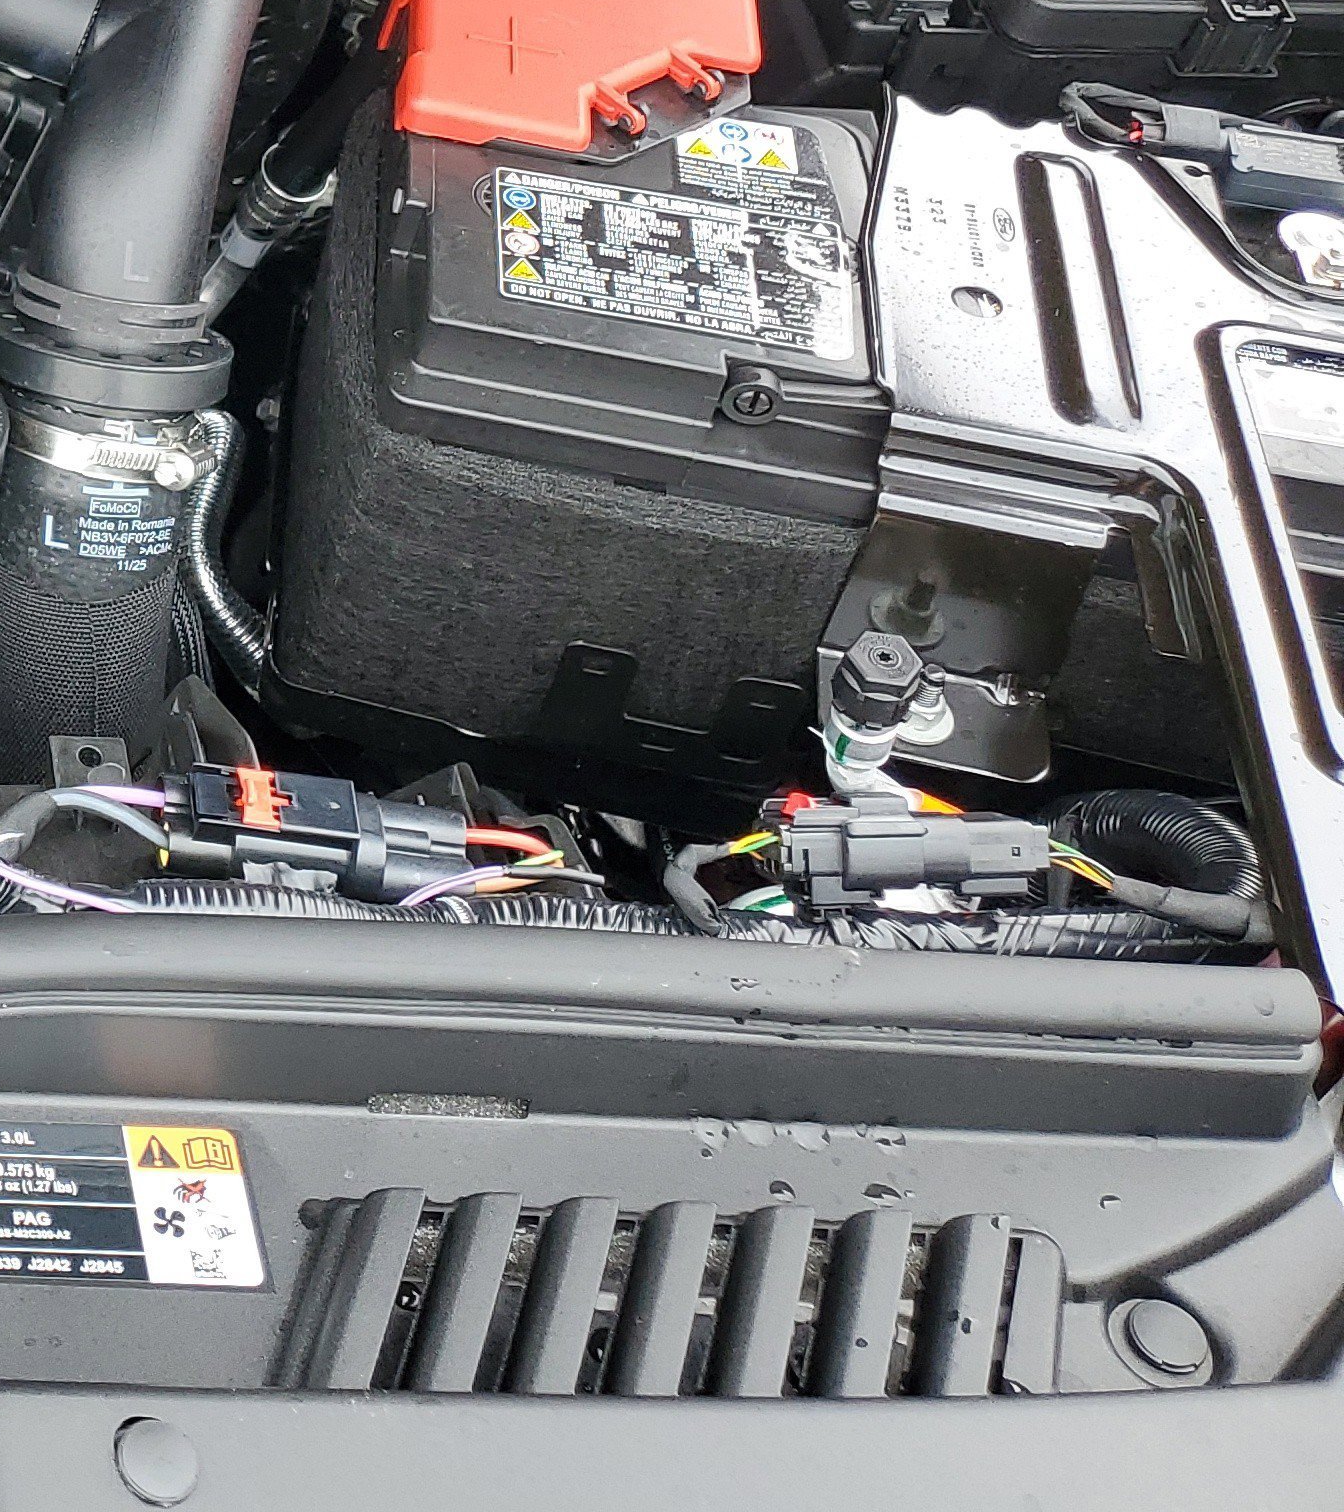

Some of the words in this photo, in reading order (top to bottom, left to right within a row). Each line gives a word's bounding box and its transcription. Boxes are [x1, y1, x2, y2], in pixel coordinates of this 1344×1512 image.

[510, 283, 527, 294] DO
[529, 286, 552, 299] NOT
[553, 290, 587, 306] OPEN.
[609, 300, 632, 313] PAS
[633, 305, 681, 322] OUVRIR.
[685, 313, 703, 326] NO
[705, 317, 720, 329] LA
[91, 501, 139, 514] FoMoCo
[79, 517, 115, 530] Made
[44, 514, 70, 550] L
[79, 543, 127, 557] D05WE
[117, 559, 148, 571] 11/25
[0, 1130, 36, 1145] 3.0L
[35, 1162, 56, 1181] kg
[4, 1181, 21, 1192] oz
[22, 1180, 51, 1195] (1.27
[53, 1180, 78, 1196] lbs)
[12, 1210, 52, 1226] PAG
